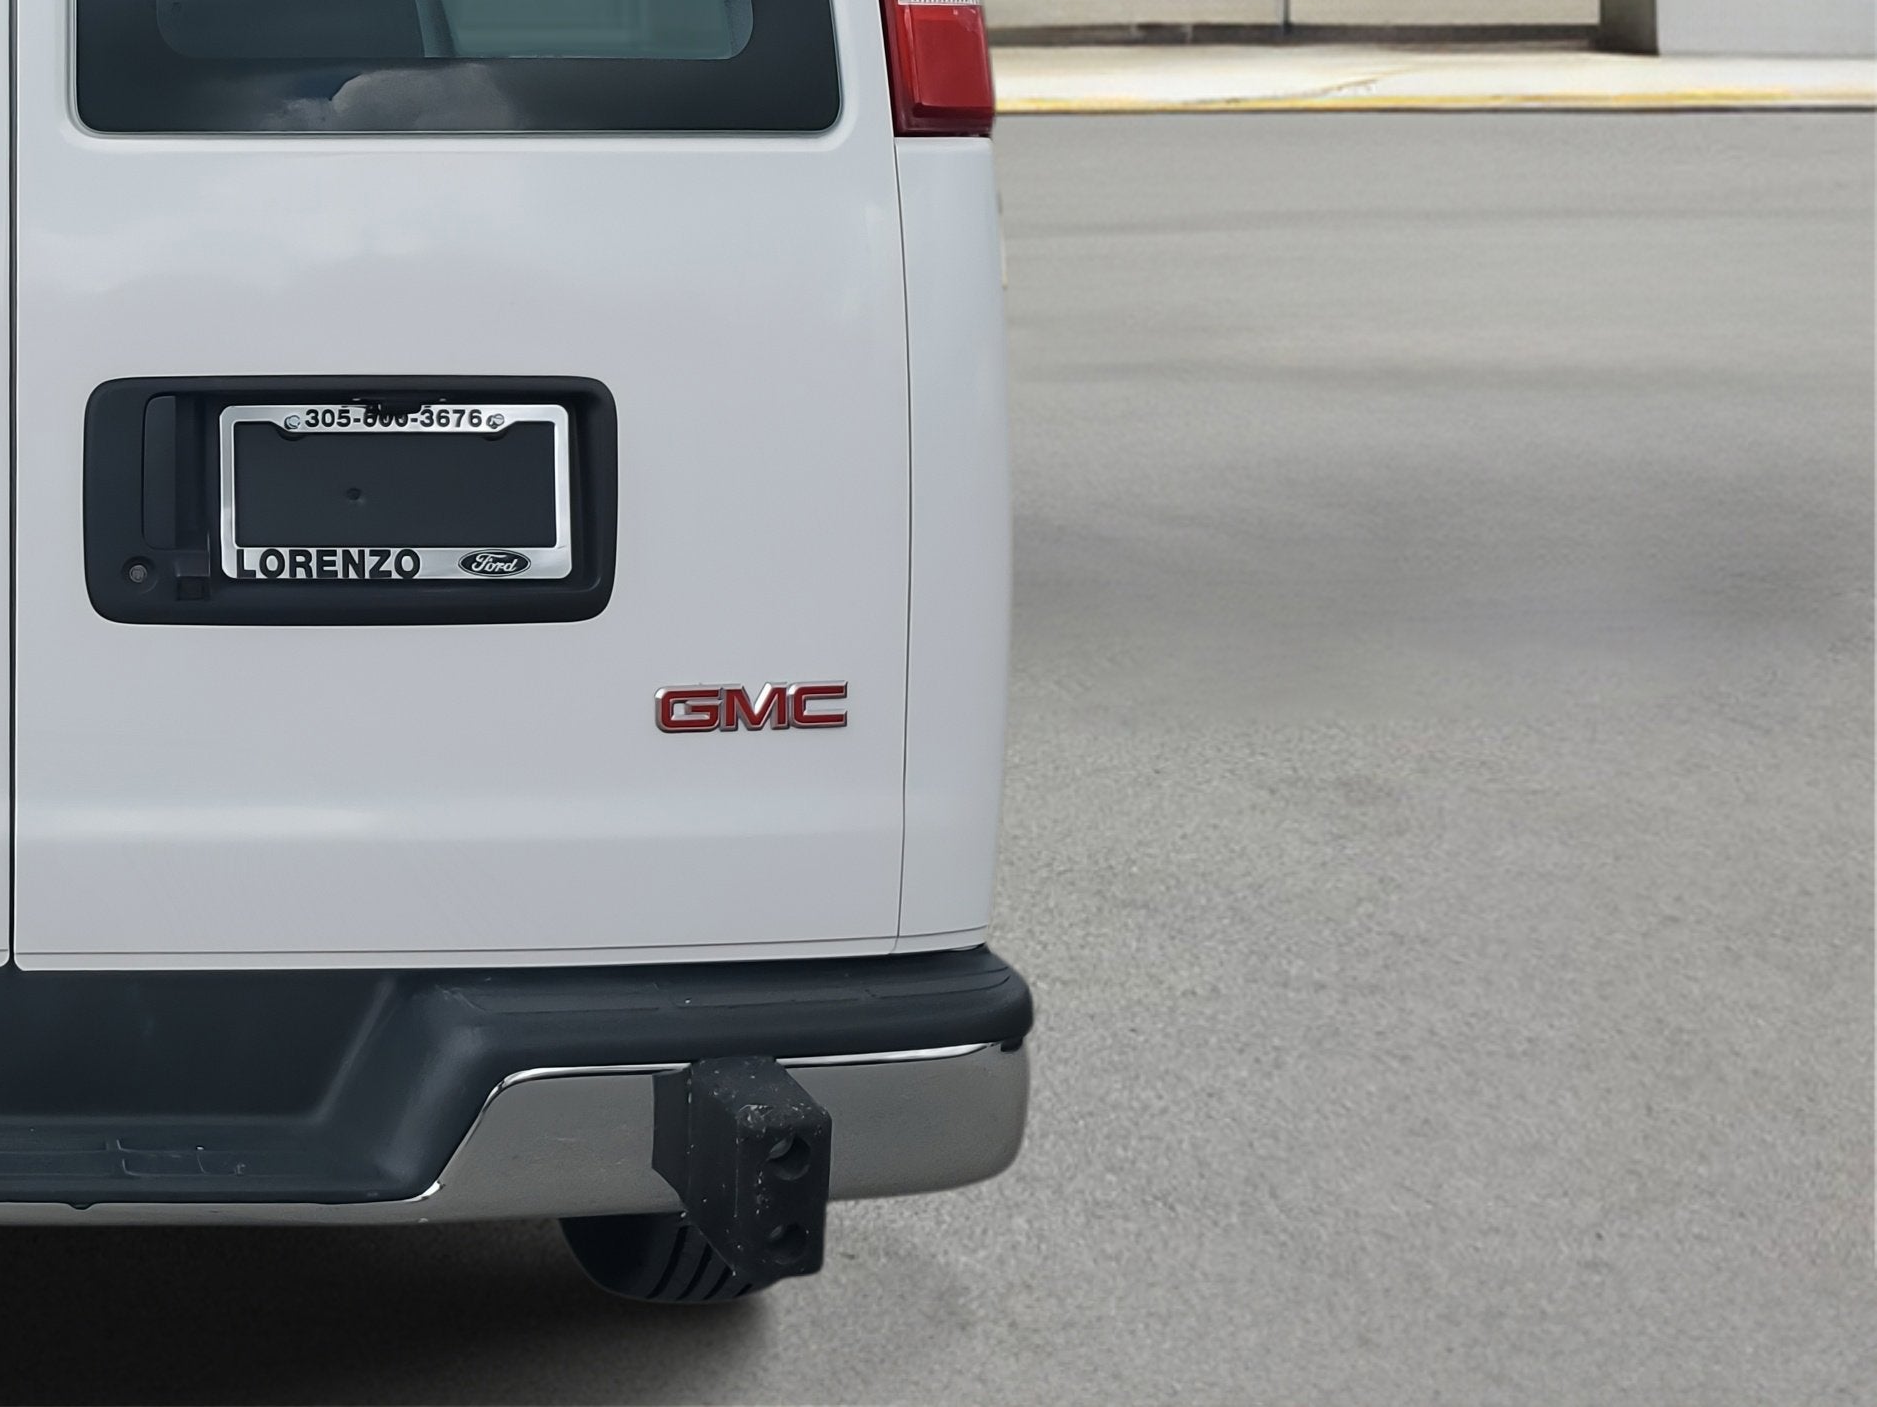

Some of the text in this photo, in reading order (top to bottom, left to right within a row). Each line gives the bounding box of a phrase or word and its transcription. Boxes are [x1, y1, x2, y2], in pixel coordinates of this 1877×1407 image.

[235, 548, 518, 579] LORENZO Ford
[654, 680, 848, 733] GMC
